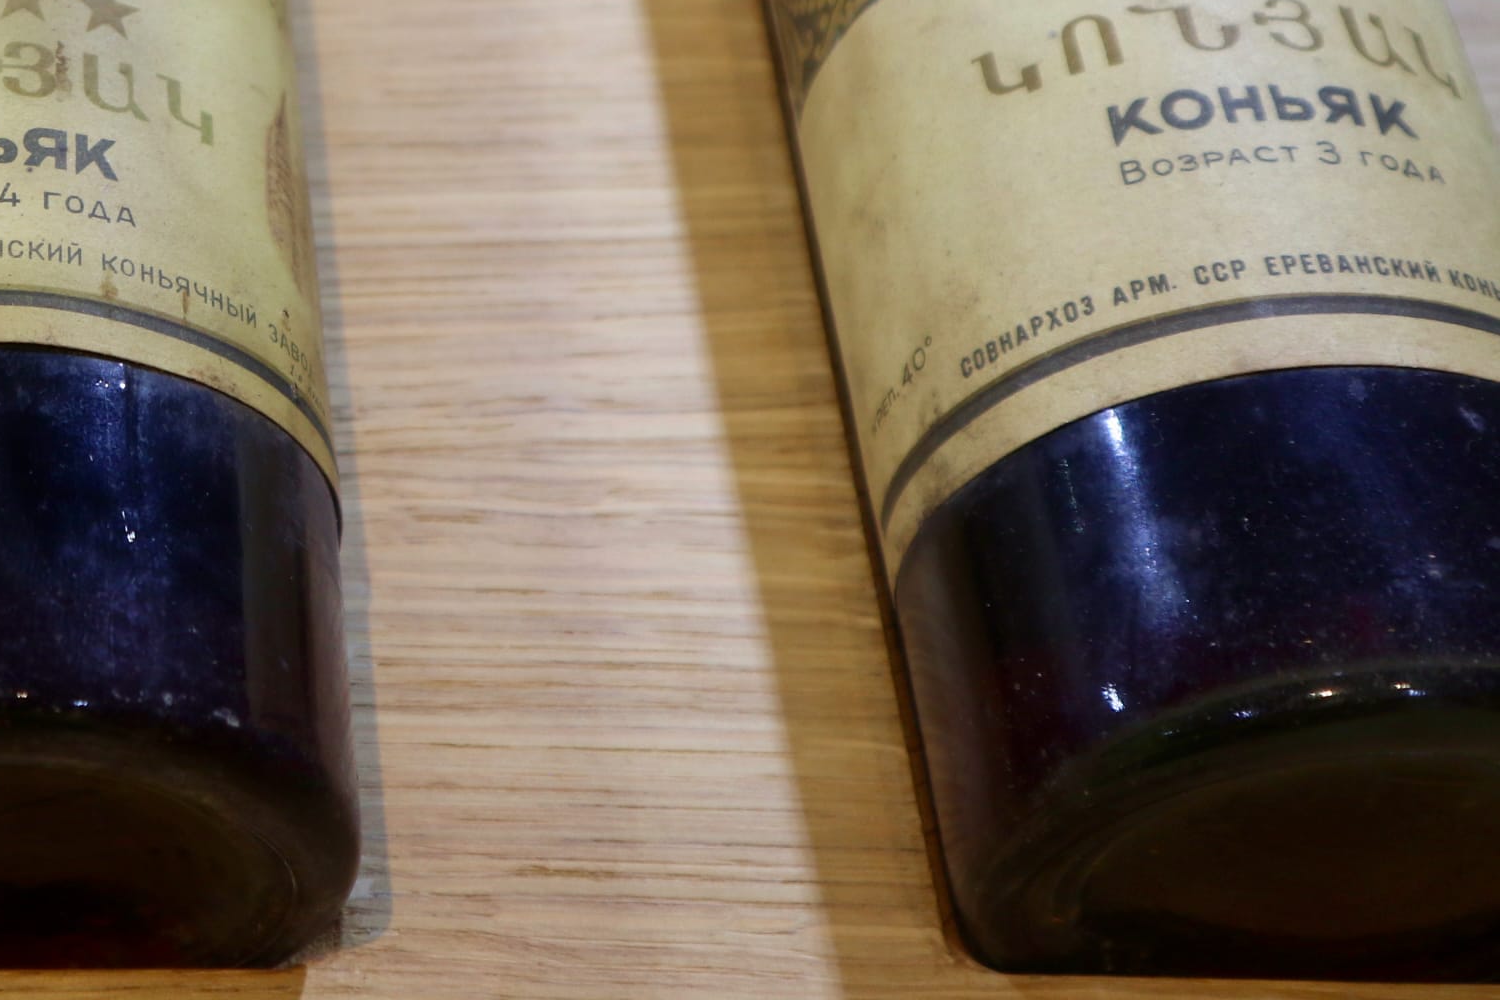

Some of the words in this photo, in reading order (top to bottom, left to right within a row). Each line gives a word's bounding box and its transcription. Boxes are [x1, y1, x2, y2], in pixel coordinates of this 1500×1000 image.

[1106, 84, 1420, 147] КОНЬЯК
[1316, 141, 1341, 165] 3
[43, 191, 137, 228] ГОДА
[102, 253, 257, 328] КОНЬЯЧНЫЙ
[960, 295, 1096, 379] СОВНАРХОЗ
[1112, 273, 1177, 306] АРМ.
[1193, 259, 1246, 286] ССР
[1264, 253, 1442, 283] ЕРЕВАНСКИЙ
